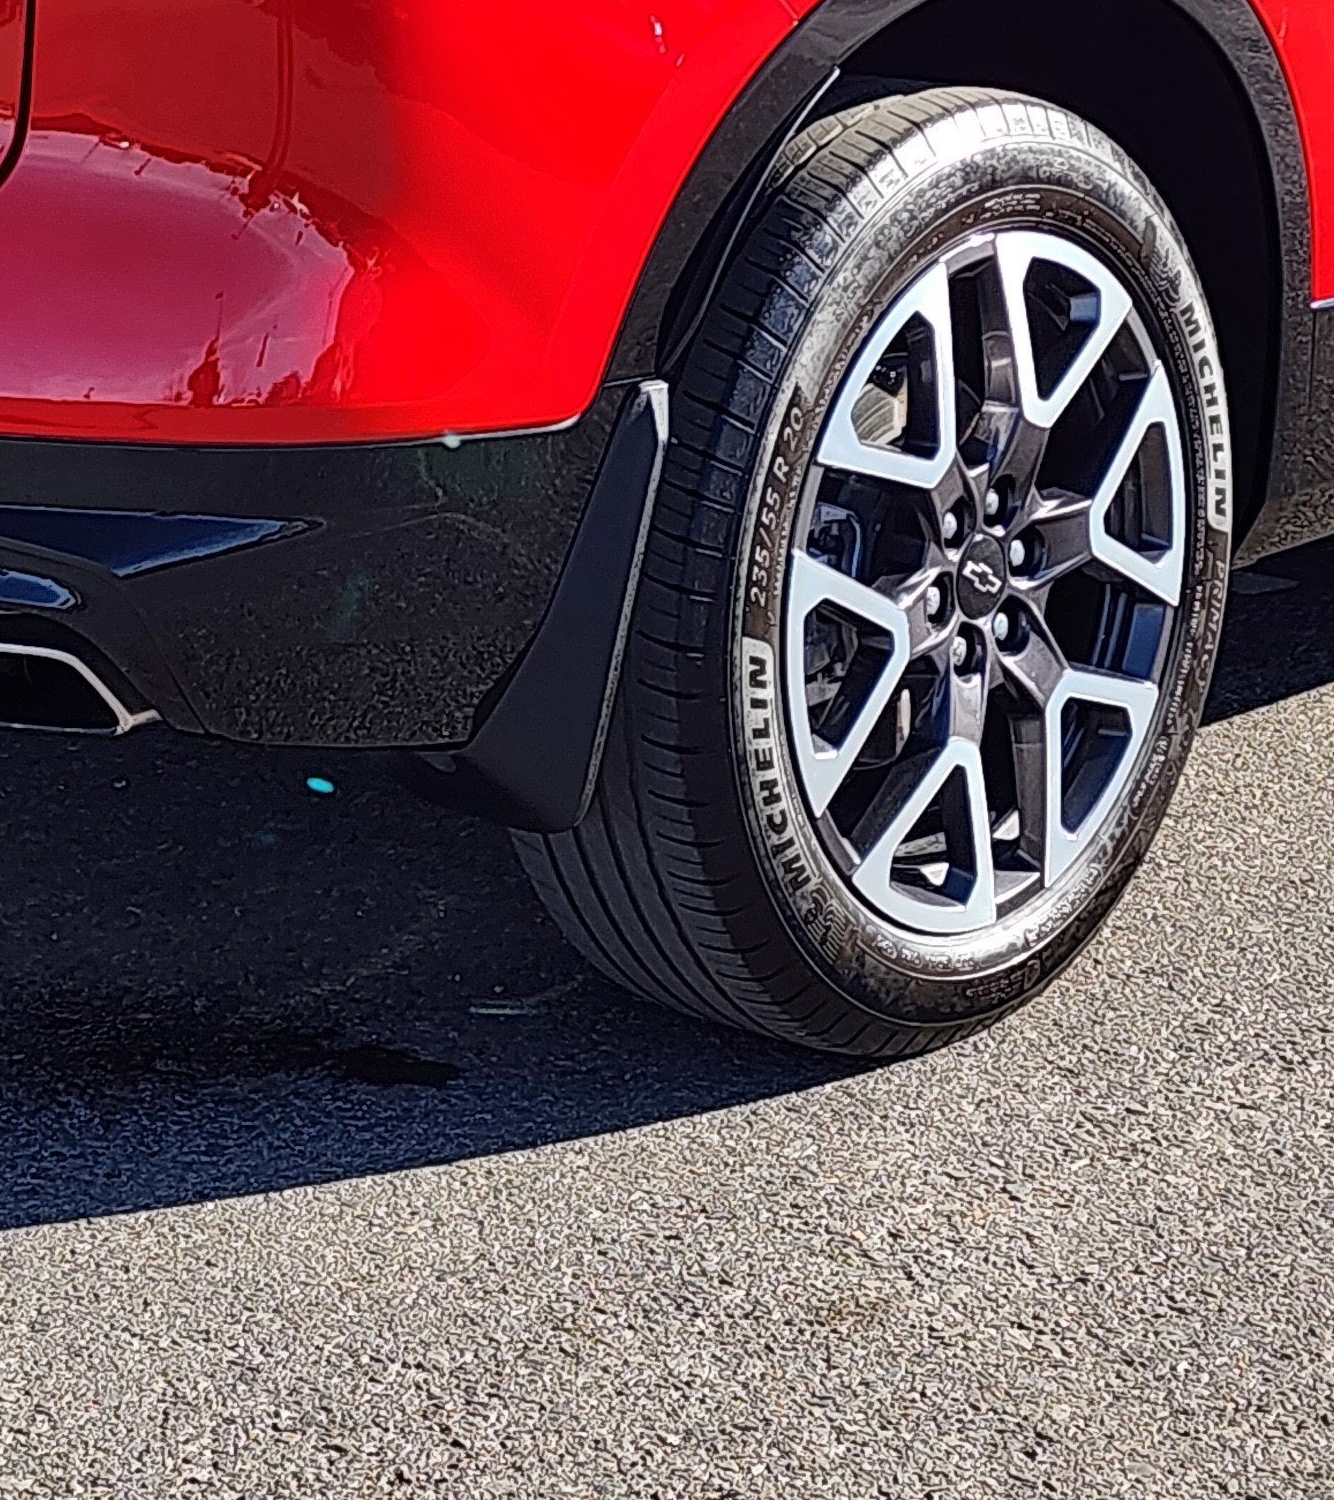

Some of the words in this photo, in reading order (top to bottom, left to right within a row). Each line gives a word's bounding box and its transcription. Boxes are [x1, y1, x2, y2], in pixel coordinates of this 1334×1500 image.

[750, 486, 781, 608] 235/55
[773, 456, 789, 483] R
[783, 407, 804, 451] 20
[1180, 301, 1227, 518] MICHELIN
[748, 654, 812, 894] MICHELIN
